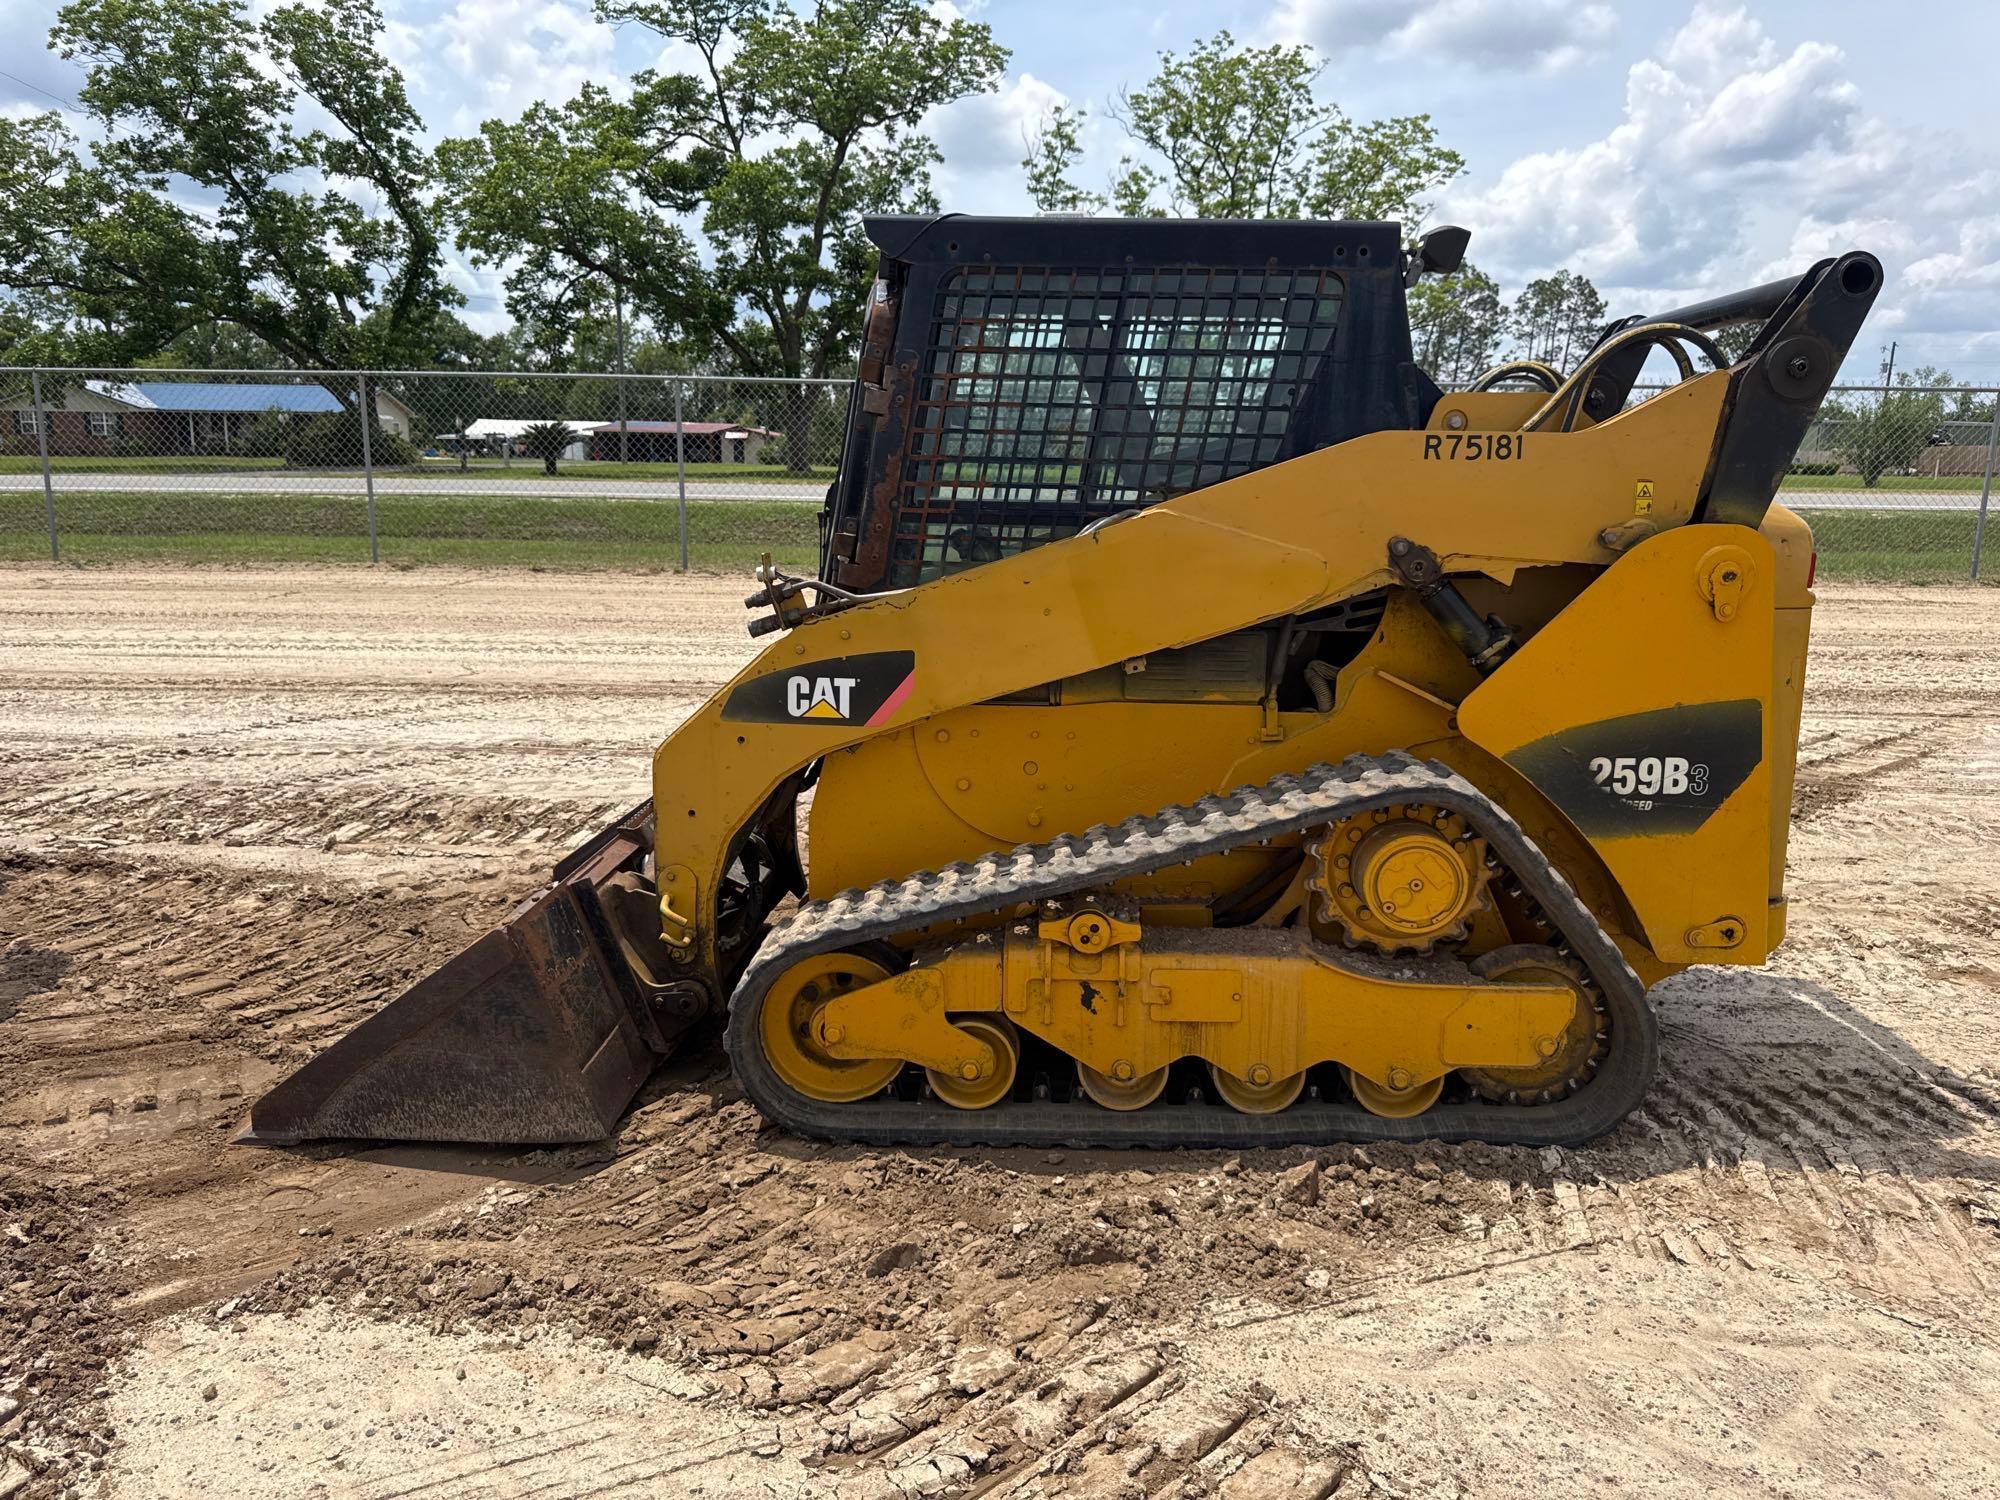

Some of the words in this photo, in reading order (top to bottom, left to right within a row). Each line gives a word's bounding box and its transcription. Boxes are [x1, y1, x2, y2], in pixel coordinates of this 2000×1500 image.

[1424, 435, 1523, 460] R75181
[787, 675, 856, 719] CAT
[1620, 799, 1653, 811] EED
